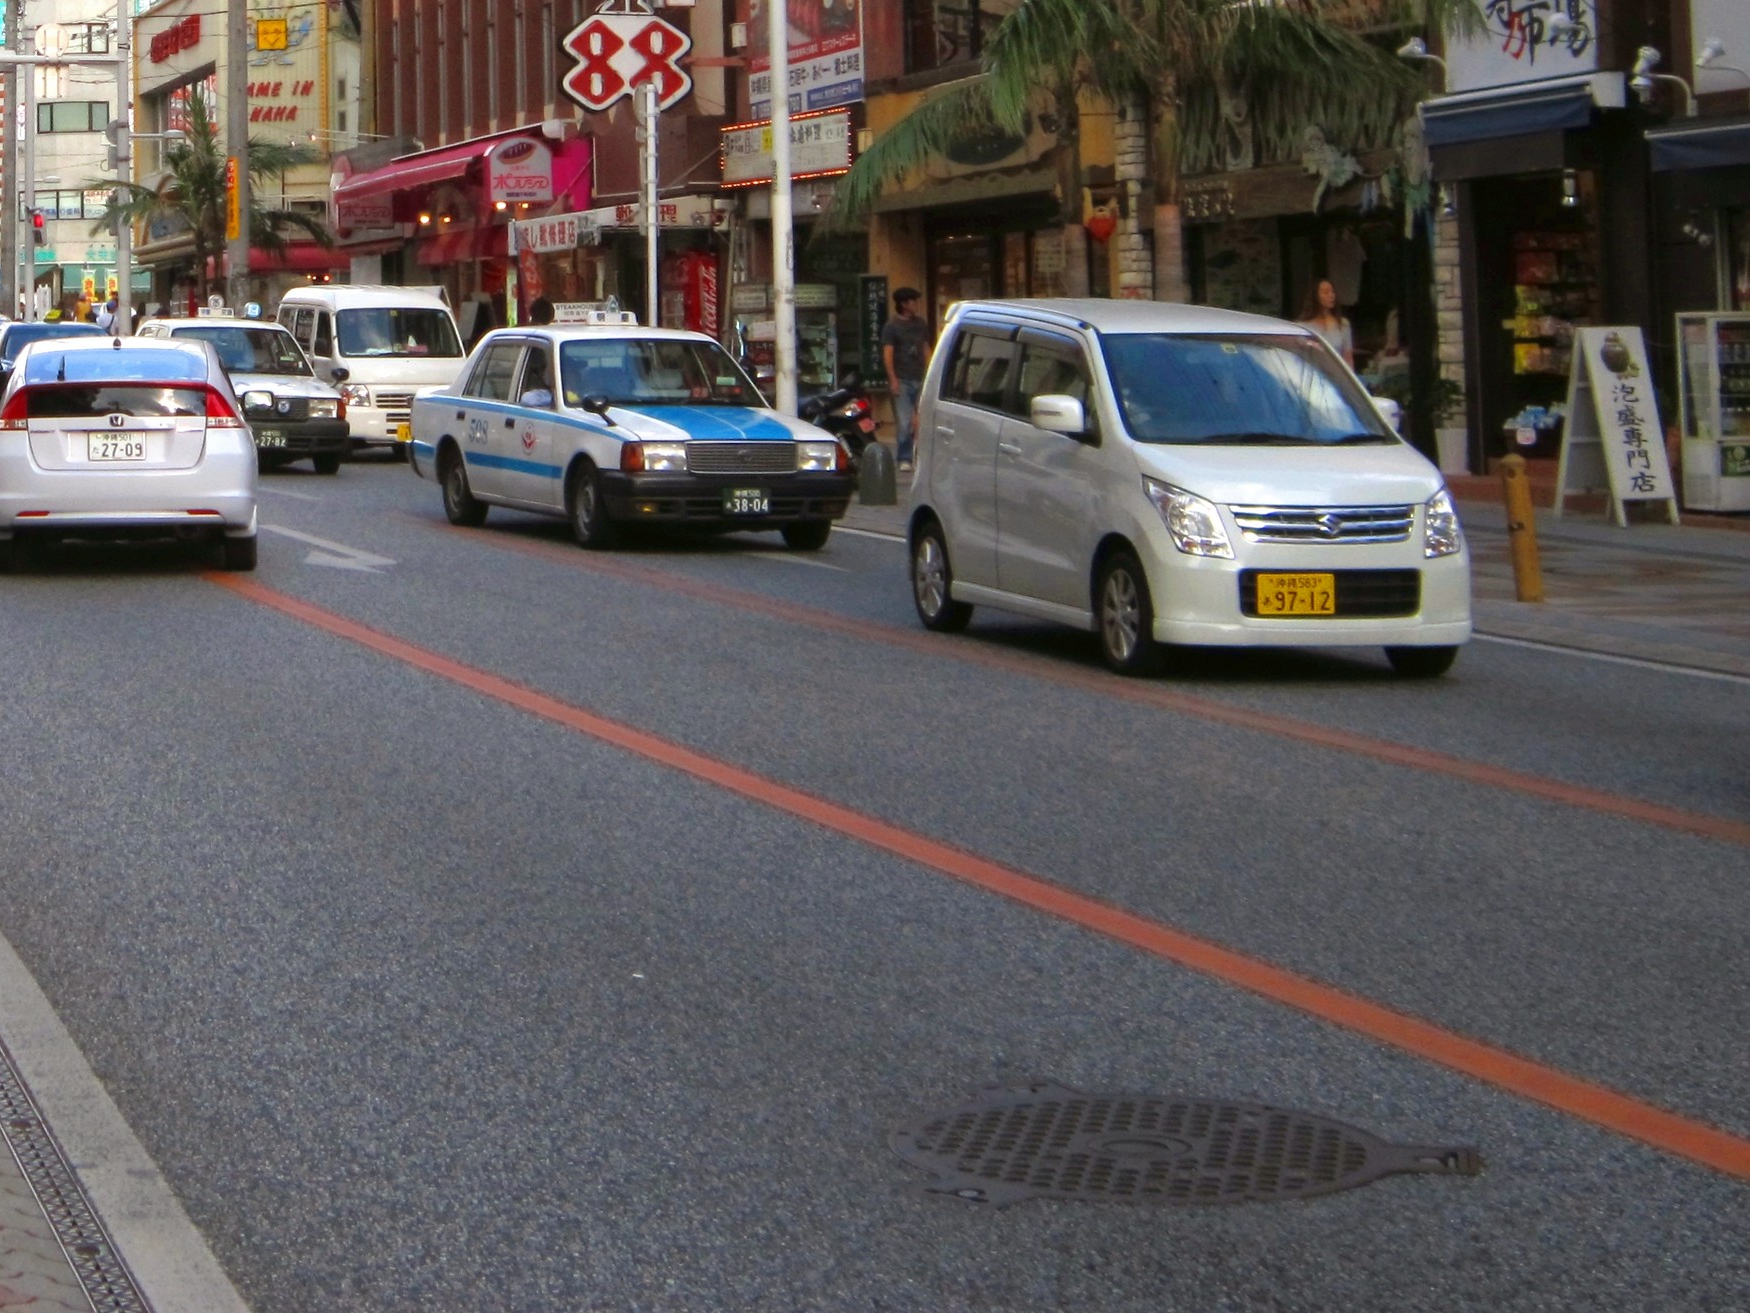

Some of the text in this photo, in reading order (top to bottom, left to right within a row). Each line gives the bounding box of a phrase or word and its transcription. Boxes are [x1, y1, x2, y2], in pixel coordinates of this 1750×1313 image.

[568, 19, 685, 106] 88
[250, 105, 299, 123] NAHA
[1611, 383, 1658, 493] 泡盛専門店
[101, 442, 144, 458] 27-09
[734, 498, 769, 513] 38-04
[1275, 591, 1331, 611] 97-12
